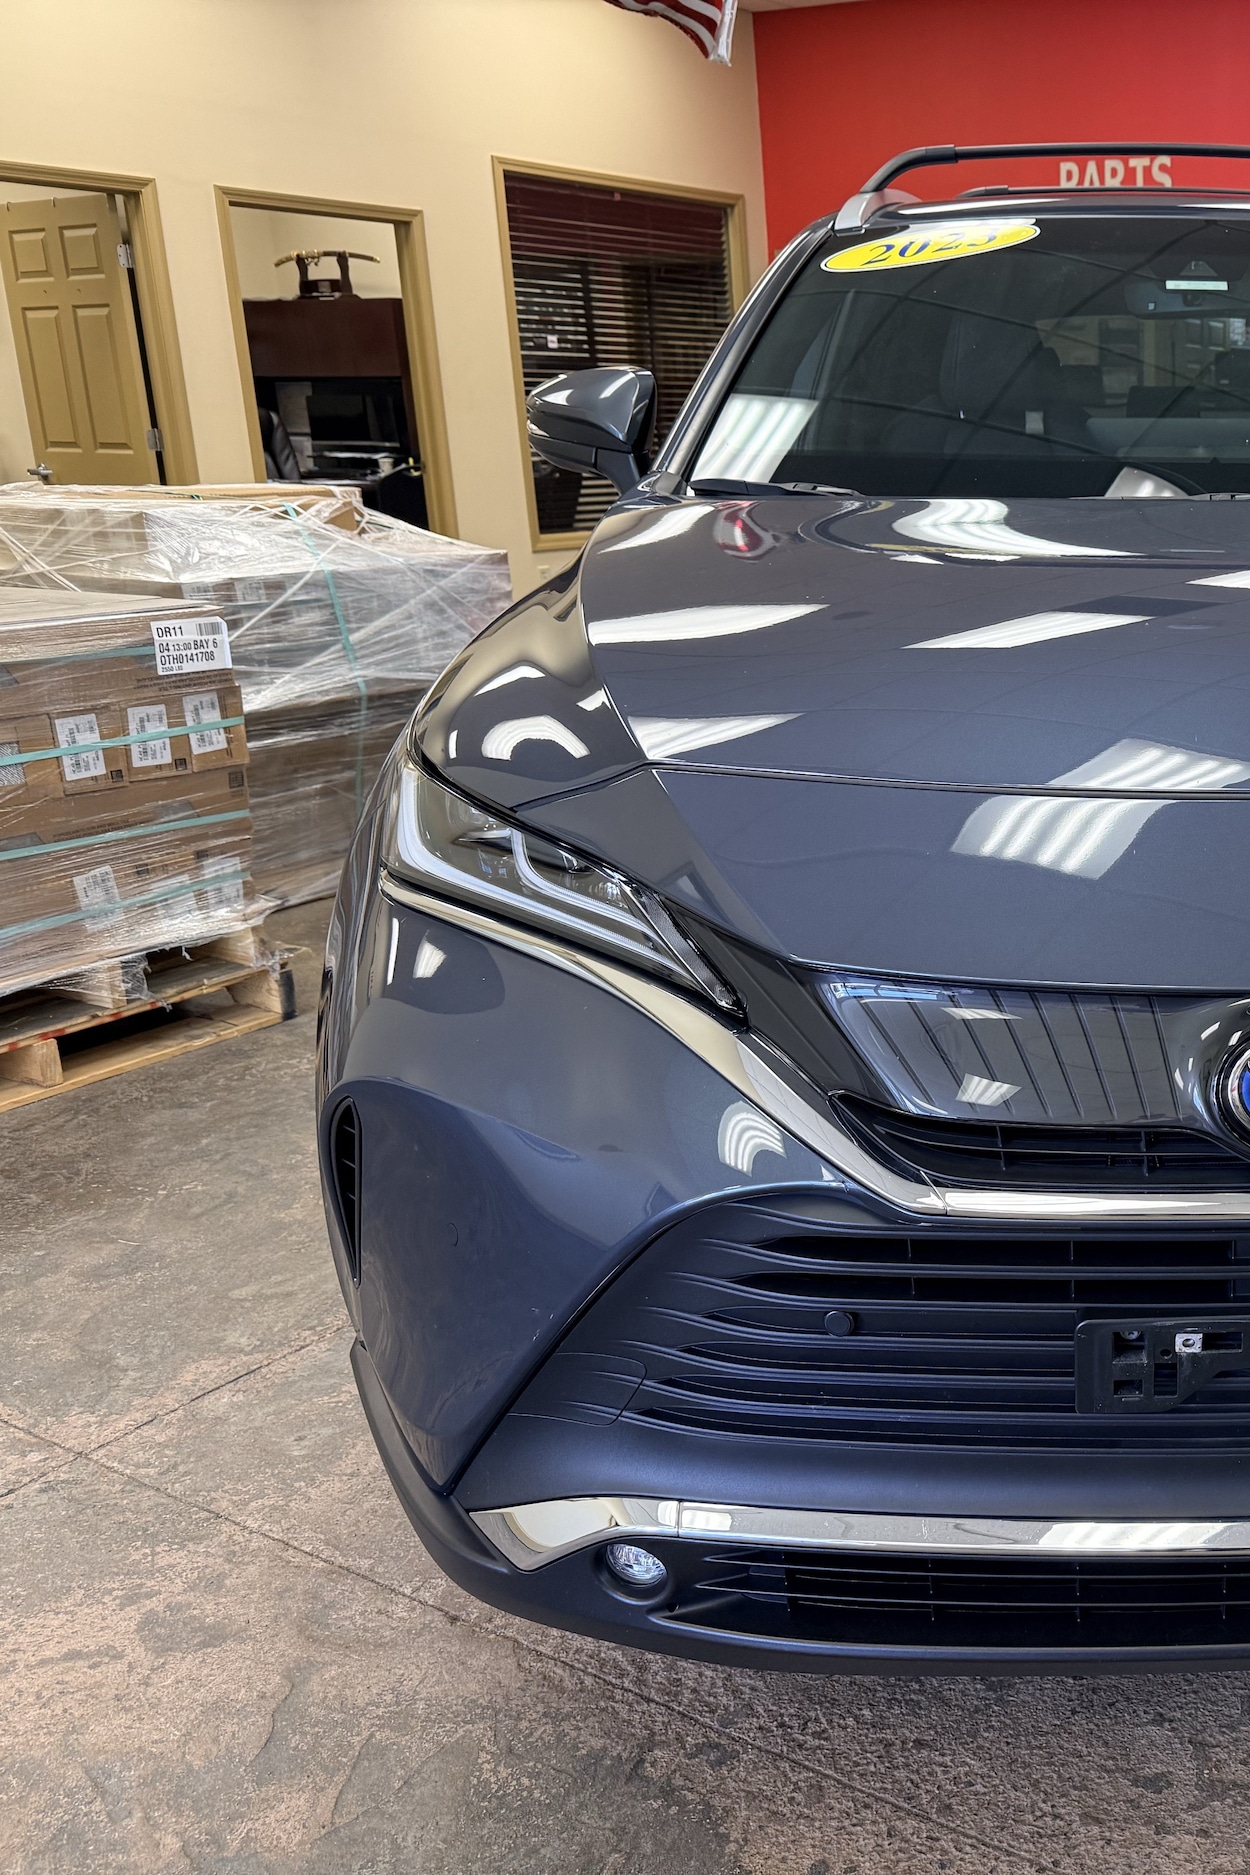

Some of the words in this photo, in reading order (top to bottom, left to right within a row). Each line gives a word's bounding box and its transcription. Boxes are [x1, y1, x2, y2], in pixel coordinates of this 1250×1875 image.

[1060, 155, 1173, 188] PARTS
[156, 625, 184, 638] DR11
[158, 642, 170, 654] 04
[172, 642, 192, 652] 13:00
[193, 638, 210, 650] BAY
[212, 638, 218, 649] 6
